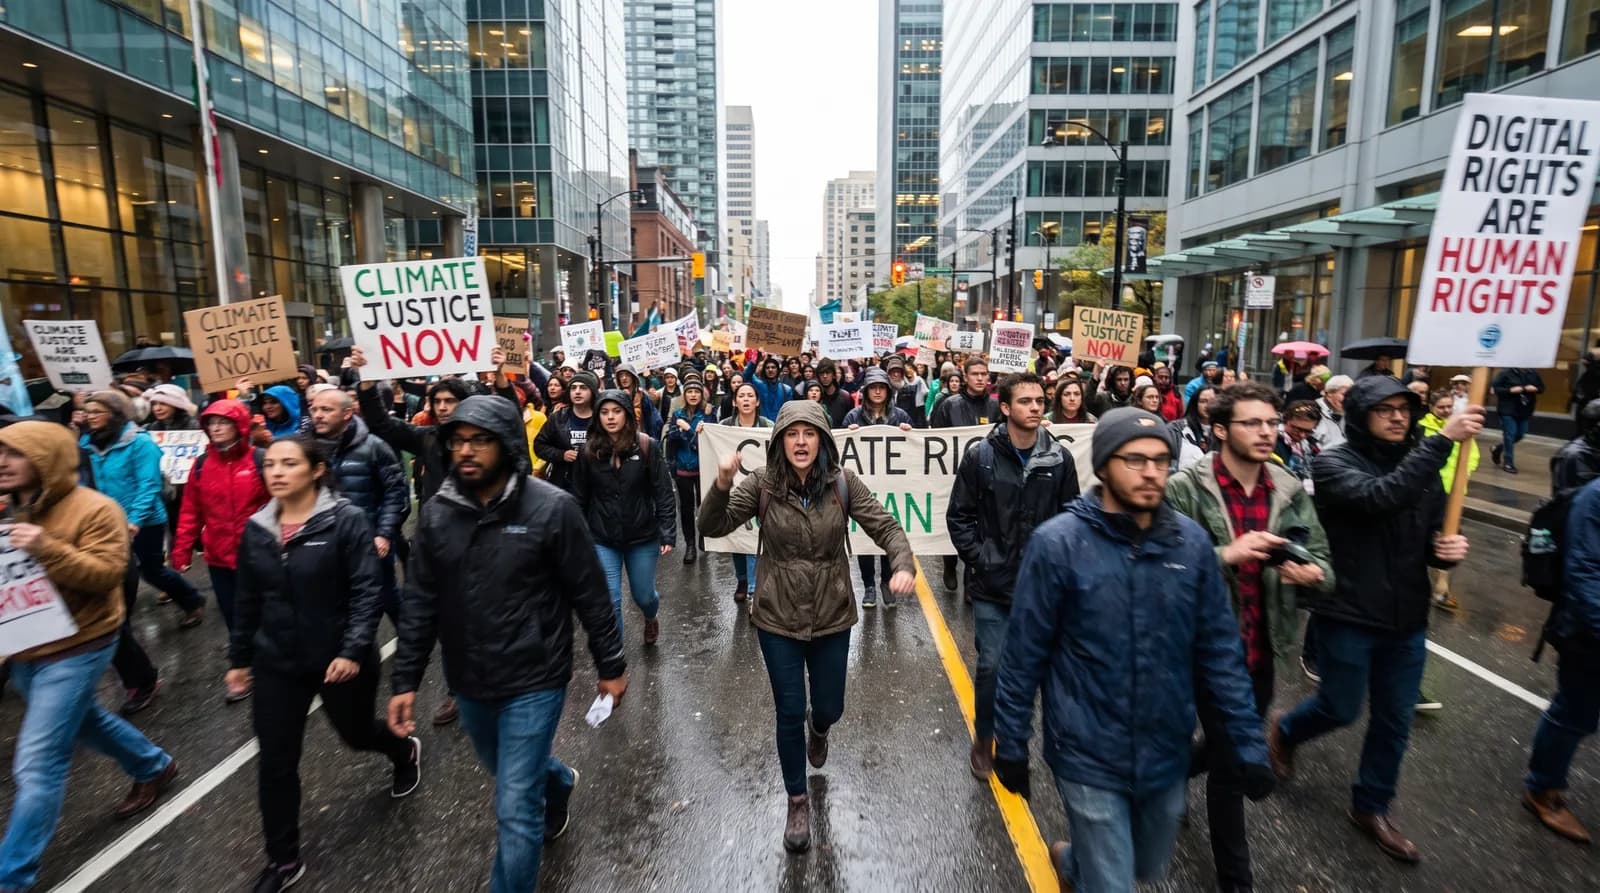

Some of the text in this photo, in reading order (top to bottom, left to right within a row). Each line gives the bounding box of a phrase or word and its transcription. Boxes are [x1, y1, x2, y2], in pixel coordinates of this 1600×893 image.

[1466, 114, 1592, 156] DIGITAL
[1460, 156, 1583, 197] RIGHTS
[1478, 198, 1548, 236] ARE
[1437, 237, 1570, 276] HUMAN
[354, 261, 479, 298] CLIMATE
[1430, 277, 1559, 315] RIGHTS
[33, 325, 87, 335] CLIMATE
[200, 301, 281, 332] CLIMATE
[362, 294, 485, 330] JUSTICE
[1079, 308, 1139, 330] CLIMATE
[39, 336, 88, 345] JUSTICE
[206, 325, 280, 354] JUSTICE
[379, 325, 481, 370] NOW
[1081, 324, 1134, 344] JUSTICE
[1087, 338, 1126, 360] NOW
[214, 347, 272, 379] NOW
[736, 436, 907, 475] CATE
